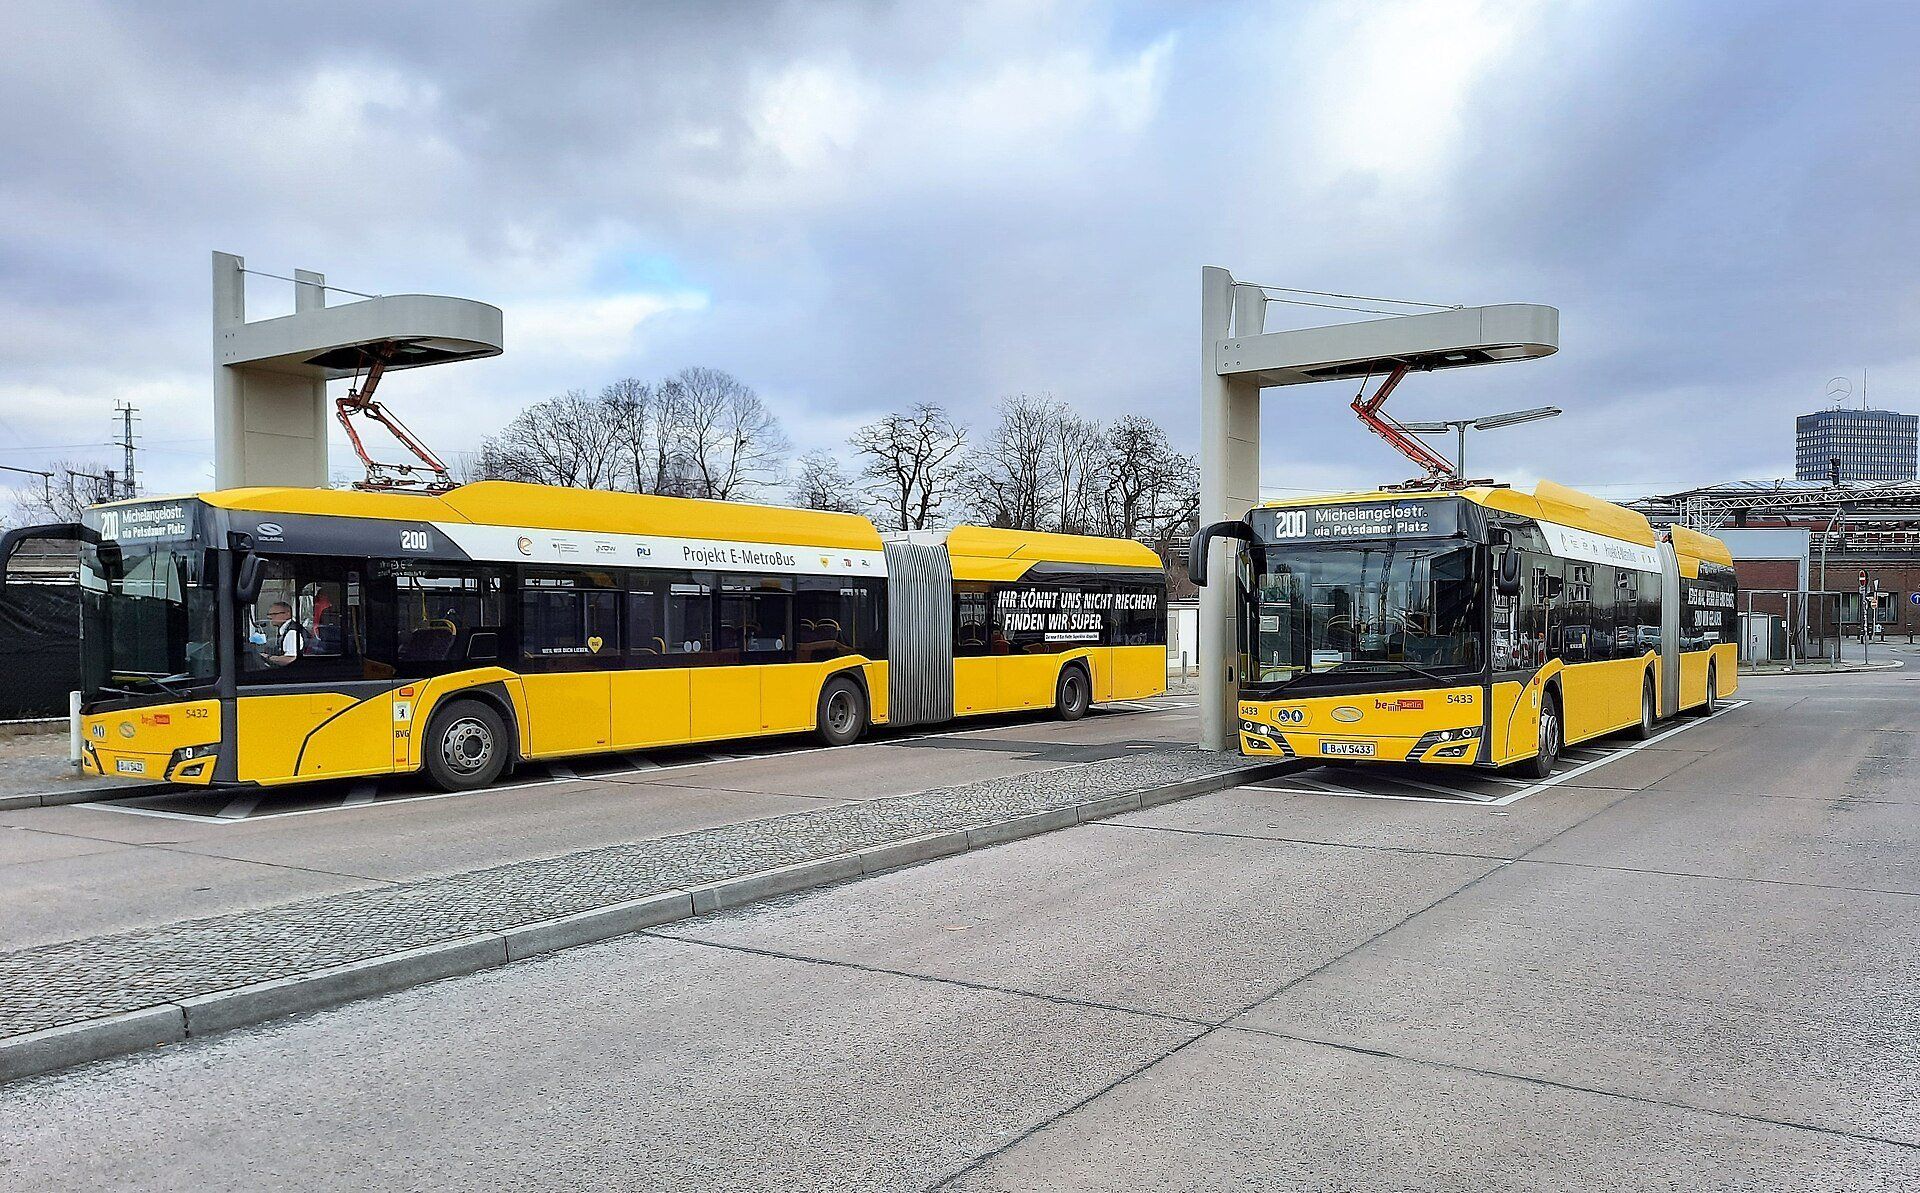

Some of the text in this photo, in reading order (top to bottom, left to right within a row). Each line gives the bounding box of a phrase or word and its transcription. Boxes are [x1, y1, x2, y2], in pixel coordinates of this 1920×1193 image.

[122, 506, 185, 523] Michelangelostr.
[1315, 505, 1428, 523] Michelangelostr.
[101, 511, 119, 540] 200
[167, 522, 186, 535] Platz
[1275, 510, 1307, 539] 200
[1314, 521, 1429, 537] via Potsdamer Platz
[401, 531, 428, 550] 200
[683, 546, 796, 567] Projekt E-MetroBus
[998, 588, 1157, 610] IHR KÖNNT UNS NICHT RIECHEN?
[1004, 613, 1104, 631] FINDEN WIR SUPER.
[1447, 694, 1473, 704] 5433
[186, 709, 208, 718] 5432
[1241, 706, 1258, 716] 5433
[395, 730, 410, 739] BVG
[1348, 744, 1371, 755] 5433
